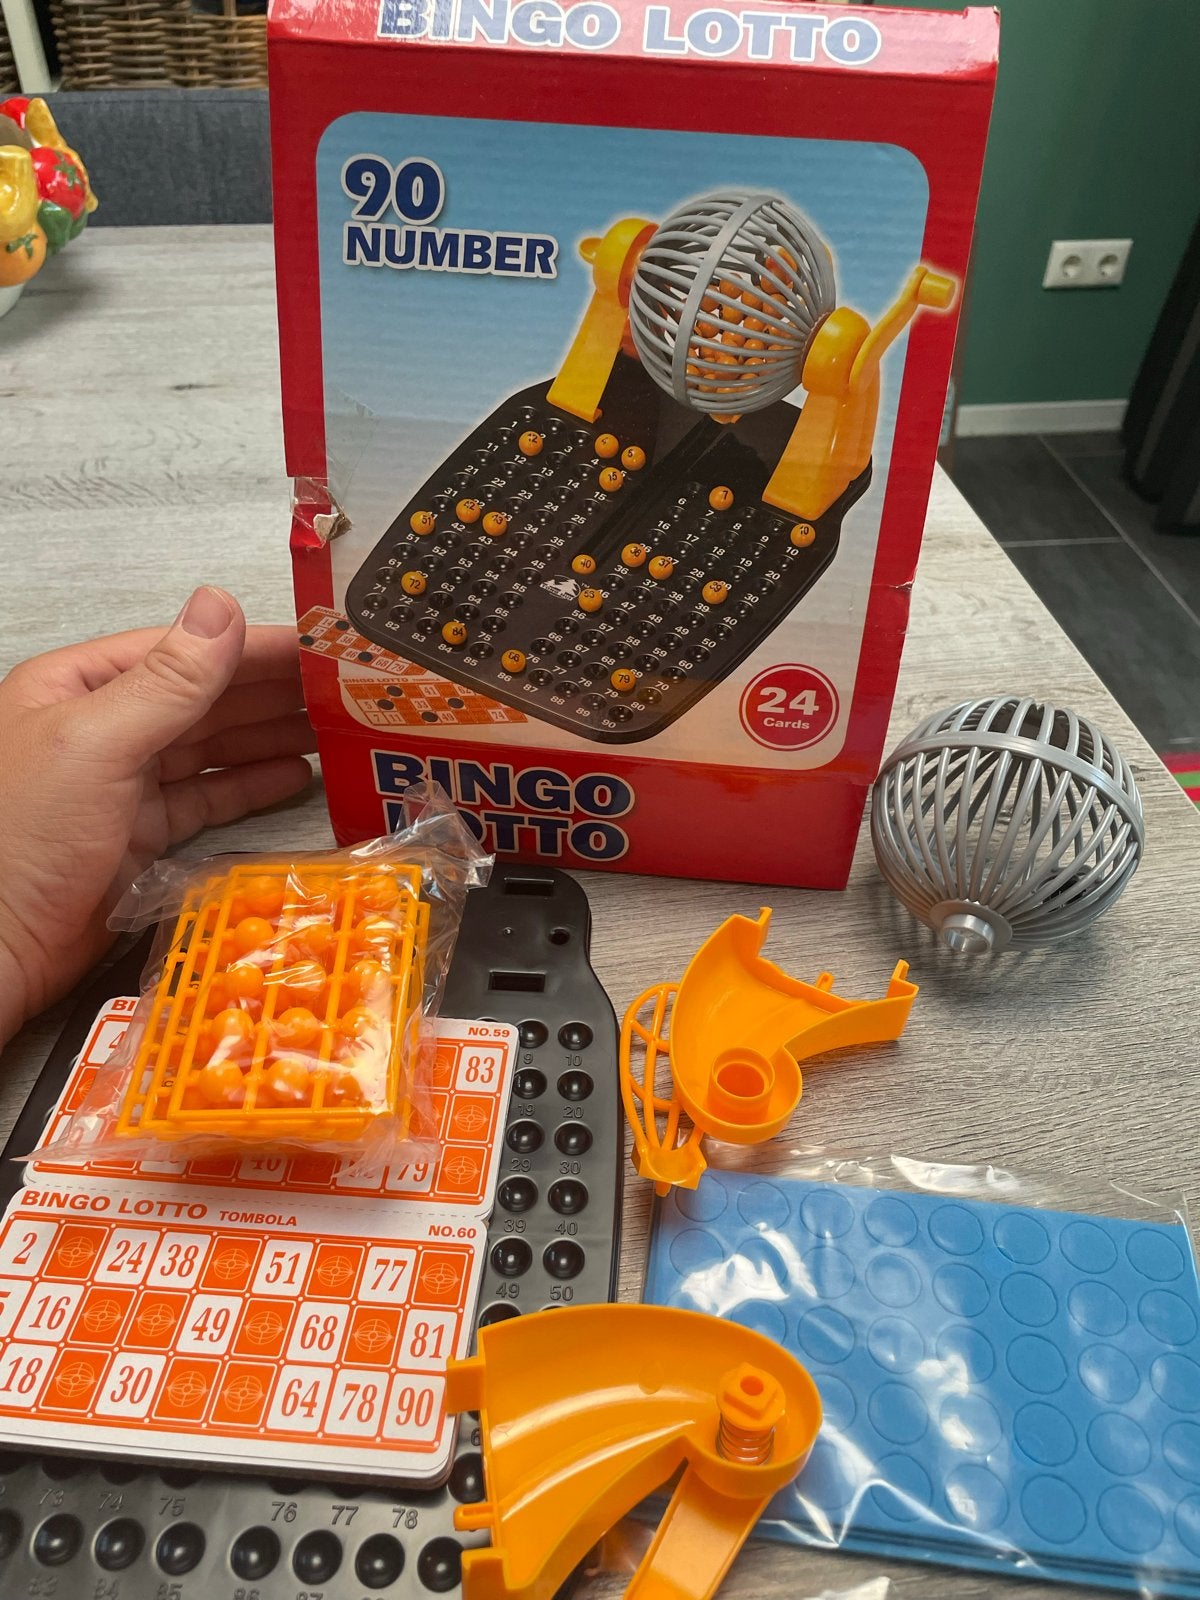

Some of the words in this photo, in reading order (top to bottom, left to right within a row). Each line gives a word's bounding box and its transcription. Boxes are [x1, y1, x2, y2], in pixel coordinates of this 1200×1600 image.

[379, 0, 620, 50] BINGO
[644, 8, 880, 64] LOTTO
[342, 155, 445, 224] 90
[345, 226, 558, 278] NUMBER
[486, 442, 499, 452] 11
[513, 454, 527, 465] 12
[540, 467, 554, 477] 13
[567, 478, 580, 489] 14
[593, 491, 607, 501] 15
[564, 445, 573, 453] 3
[591, 458, 600, 466] 4
[444, 487, 458, 497] 31
[523, 524, 539, 534] 34
[550, 536, 565, 547] 35
[464, 465, 479, 475] 21
[491, 477, 506, 488] 22
[517, 489, 533, 500] 23
[544, 501, 559, 512] 24
[570, 514, 586, 525] 25
[722, 490, 729, 500] 7
[451, 521, 466, 533] 42
[477, 535, 493, 545] 43
[503, 547, 518, 558] 44
[530, 559, 546, 569] 45
[657, 520, 671, 531] 16
[685, 533, 700, 543] 17
[712, 546, 726, 556] 18
[738, 557, 753, 567] 19
[765, 570, 781, 581] 20
[678, 497, 687, 505] 6
[760, 535, 769, 543] 9
[785, 546, 800, 556] 10
[388, 558, 403, 568] 61
[440, 582, 455, 592] 63
[467, 594, 482, 605] 64
[494, 607, 510, 617] 65
[406, 533, 420, 544] 51
[432, 546, 447, 557] 52
[458, 557, 473, 568] 53
[484, 570, 500, 581] 54
[512, 582, 528, 593] 55
[409, 577, 421, 590] 72
[689, 568, 705, 578] 28
[744, 593, 759, 604] 30
[372, 583, 387, 593] 71
[399, 595, 414, 605] 72
[425, 607, 440, 617] 73
[477, 631, 492, 641] 75
[614, 564, 629, 575] 36
[642, 578, 658, 589] 37
[668, 591, 684, 601] 38
[694, 602, 710, 613] 39
[722, 616, 738, 626] 40
[361, 609, 375, 620] 81
[385, 621, 400, 632] 82
[411, 633, 426, 643] 83
[438, 643, 453, 654] 84
[463, 656, 479, 666] 85
[571, 609, 587, 620] 56
[598, 622, 614, 633] 57
[625, 635, 641, 647] 58
[652, 647, 668, 658] 59
[678, 659, 693, 670] 60
[620, 601, 636, 611] 47
[648, 613, 663, 624] 48
[674, 625, 690, 636] 49
[701, 638, 717, 648] 50
[526, 653, 541, 664] 76
[552, 665, 568, 676] 77
[577, 677, 593, 688] 78
[604, 688, 619, 698] 79
[630, 701, 646, 711] 80
[548, 632, 563, 642] 66
[574, 644, 590, 654] 67
[601, 655, 616, 666] 68
[655, 680, 670, 691] 70
[618, 674, 630, 684] 79
[497, 672, 512, 682] 86
[522, 684, 539, 694] 87
[550, 695, 566, 706] 88
[575, 707, 591, 717] 89
[601, 719, 617, 729] 90
[757, 686, 819, 716] 24
[762, 717, 811, 731] Cards
[371, 749, 635, 819] BINGO
[468, 1026, 511, 1039] NO.59
[465, 1054, 497, 1084] 83
[523, 1053, 534, 1065] 9
[565, 1055, 583, 1067] 10
[518, 1104, 535, 1117] 19
[563, 1106, 584, 1119] 20
[510, 1158, 531, 1172] 29
[559, 1161, 581, 1175] 30
[21, 1190, 111, 1213] BINGO
[118, 1197, 208, 1220] LOTTO
[219, 1210, 298, 1227] TOMBOLA
[428, 1224, 478, 1239] NO.60
[504, 1219, 527, 1233] 39
[555, 1221, 578, 1236] 40
[12, 1231, 38, 1264] 2
[106, 1239, 148, 1273] 24
[160, 1244, 199, 1278] 38
[265, 1251, 302, 1285] 51
[374, 1258, 408, 1292] 77
[496, 1282, 520, 1299] 49
[550, 1286, 574, 1301] 50
[28, 1295, 71, 1331] 16
[192, 1307, 232, 1343] 49
[301, 1315, 339, 1352] 68
[410, 1323, 445, 1359] 81
[0, 1356, 43, 1394] 18
[111, 1366, 153, 1405] 30
[281, 1380, 318, 1418] 64
[338, 1383, 378, 1423] 78
[396, 1387, 435, 1428] 90
[159, 1497, 186, 1517] 75
[270, 1501, 298, 1523] 76
[331, 1505, 359, 1526] 77
[392, 1508, 419, 1530] 78
